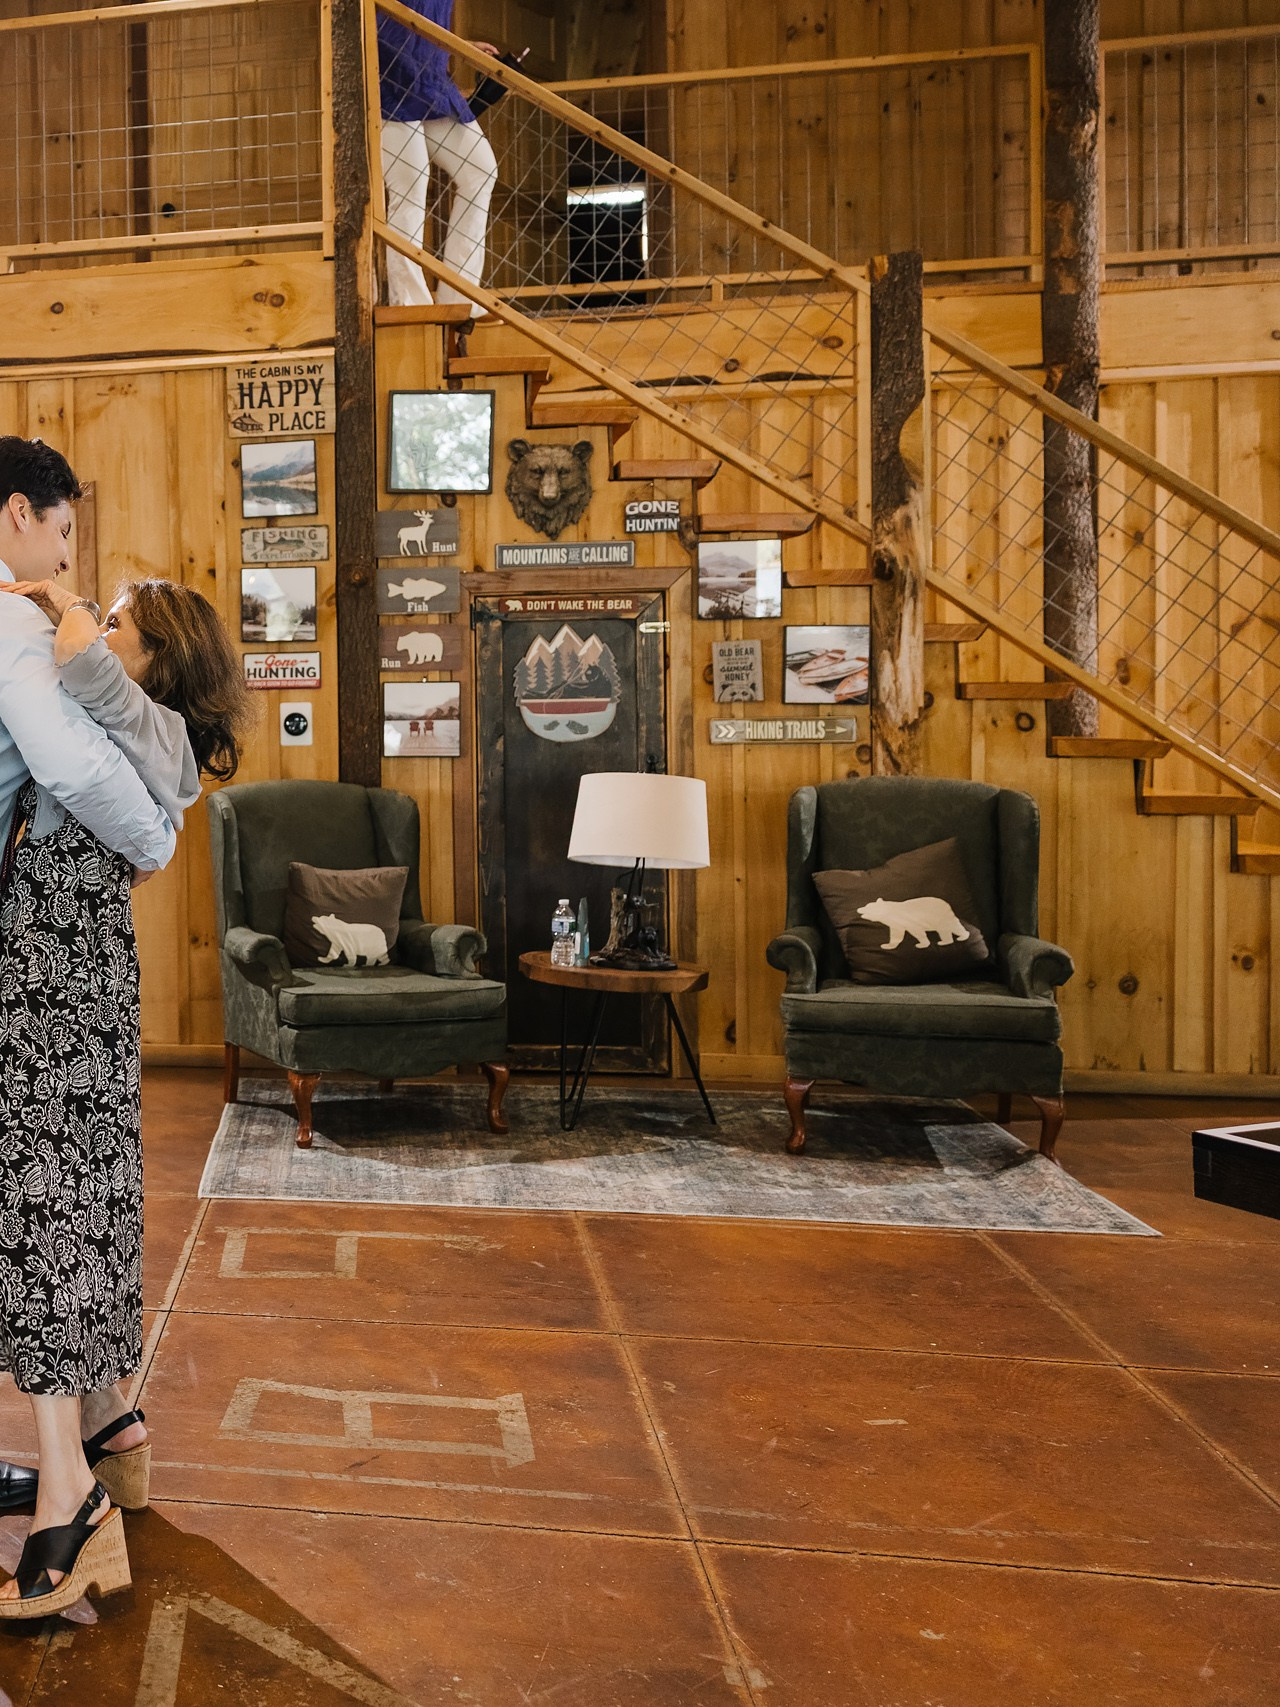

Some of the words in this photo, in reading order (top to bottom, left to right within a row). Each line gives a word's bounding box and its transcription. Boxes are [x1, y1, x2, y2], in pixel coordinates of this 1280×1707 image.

[236, 368, 257, 379] THE
[260, 366, 291, 378] CABIN
[294, 365, 304, 375] IS
[307, 364, 324, 375] MY
[237, 377, 325, 410] HAPPY
[268, 411, 326, 432] PLACE
[625, 500, 680, 515] GONE
[625, 517, 681, 532] HUNTIN'
[252, 529, 318, 543] FISHING
[432, 541, 457, 553] Hunt
[502, 547, 568, 565] MOUNTAINS
[568, 547, 580, 561] ARE
[581, 545, 628, 563] CALLING
[407, 601, 429, 612] Fish
[526, 600, 556, 611] DON'T
[558, 600, 584, 610] WAKE
[586, 600, 605, 610] THE
[607, 599, 633, 610] BEAR
[719, 648, 733, 657] OLD
[734, 647, 755, 657] BEAR
[264, 654, 298, 671] Gone
[381, 657, 401, 668] Run
[247, 666, 317, 679] HUNTING
[724, 672, 751, 681] HONEY
[745, 720, 784, 740] HIKING
[785, 720, 826, 739] TRAILS
